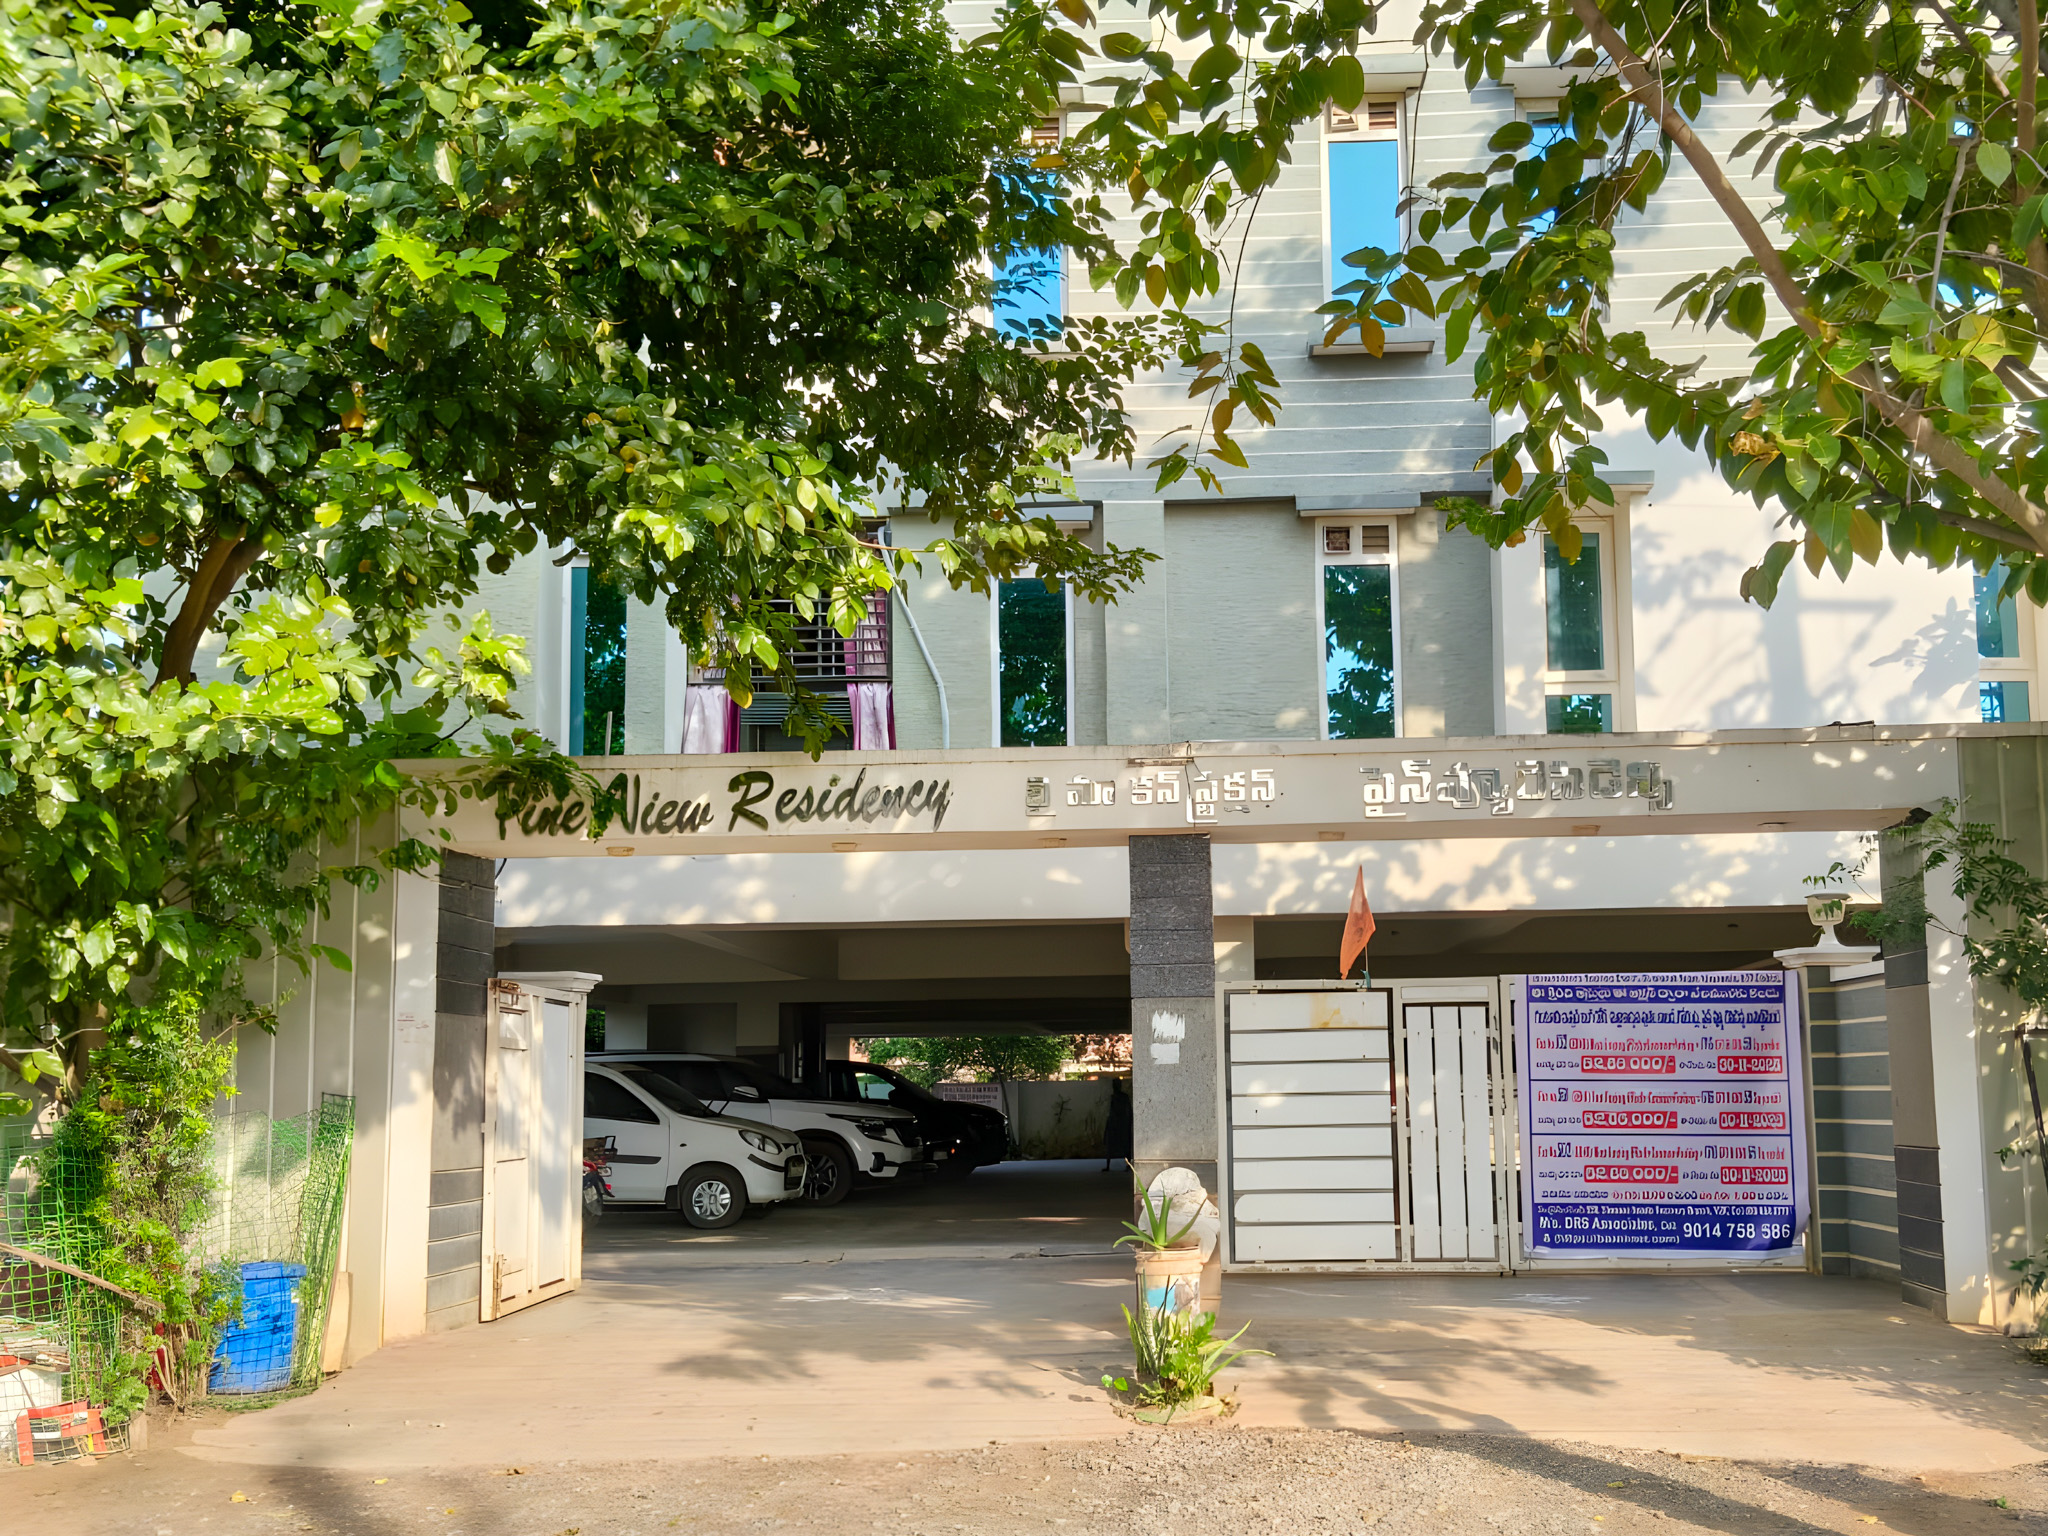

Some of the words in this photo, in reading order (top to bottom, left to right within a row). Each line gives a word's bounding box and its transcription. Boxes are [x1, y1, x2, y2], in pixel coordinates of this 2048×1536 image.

[728, 767, 953, 832] Residency
[1683, 1222, 1721, 1238] 9014
[1726, 1223, 1756, 1239] 758
